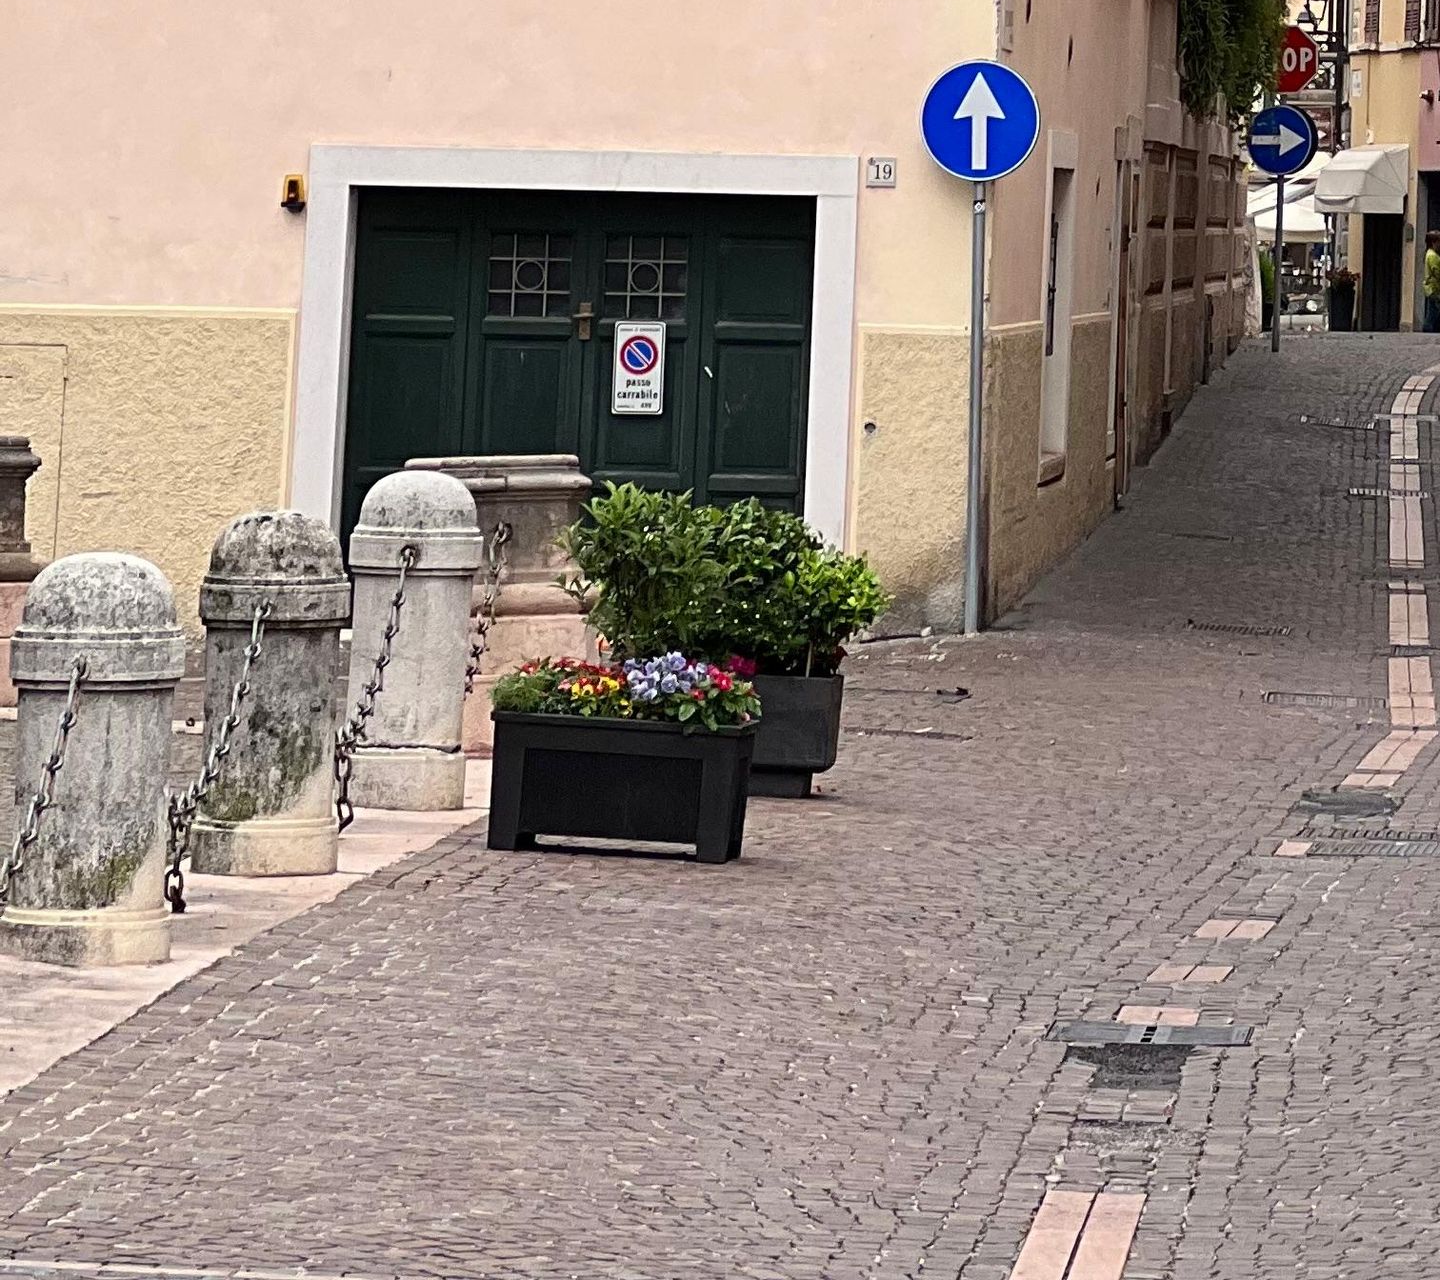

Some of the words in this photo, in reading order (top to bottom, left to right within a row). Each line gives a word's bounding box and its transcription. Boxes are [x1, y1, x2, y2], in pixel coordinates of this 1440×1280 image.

[1282, 47, 1314, 72] OP
[875, 164, 892, 180] 19
[626, 379, 651, 389] passo
[617, 389, 659, 400] carrabile
